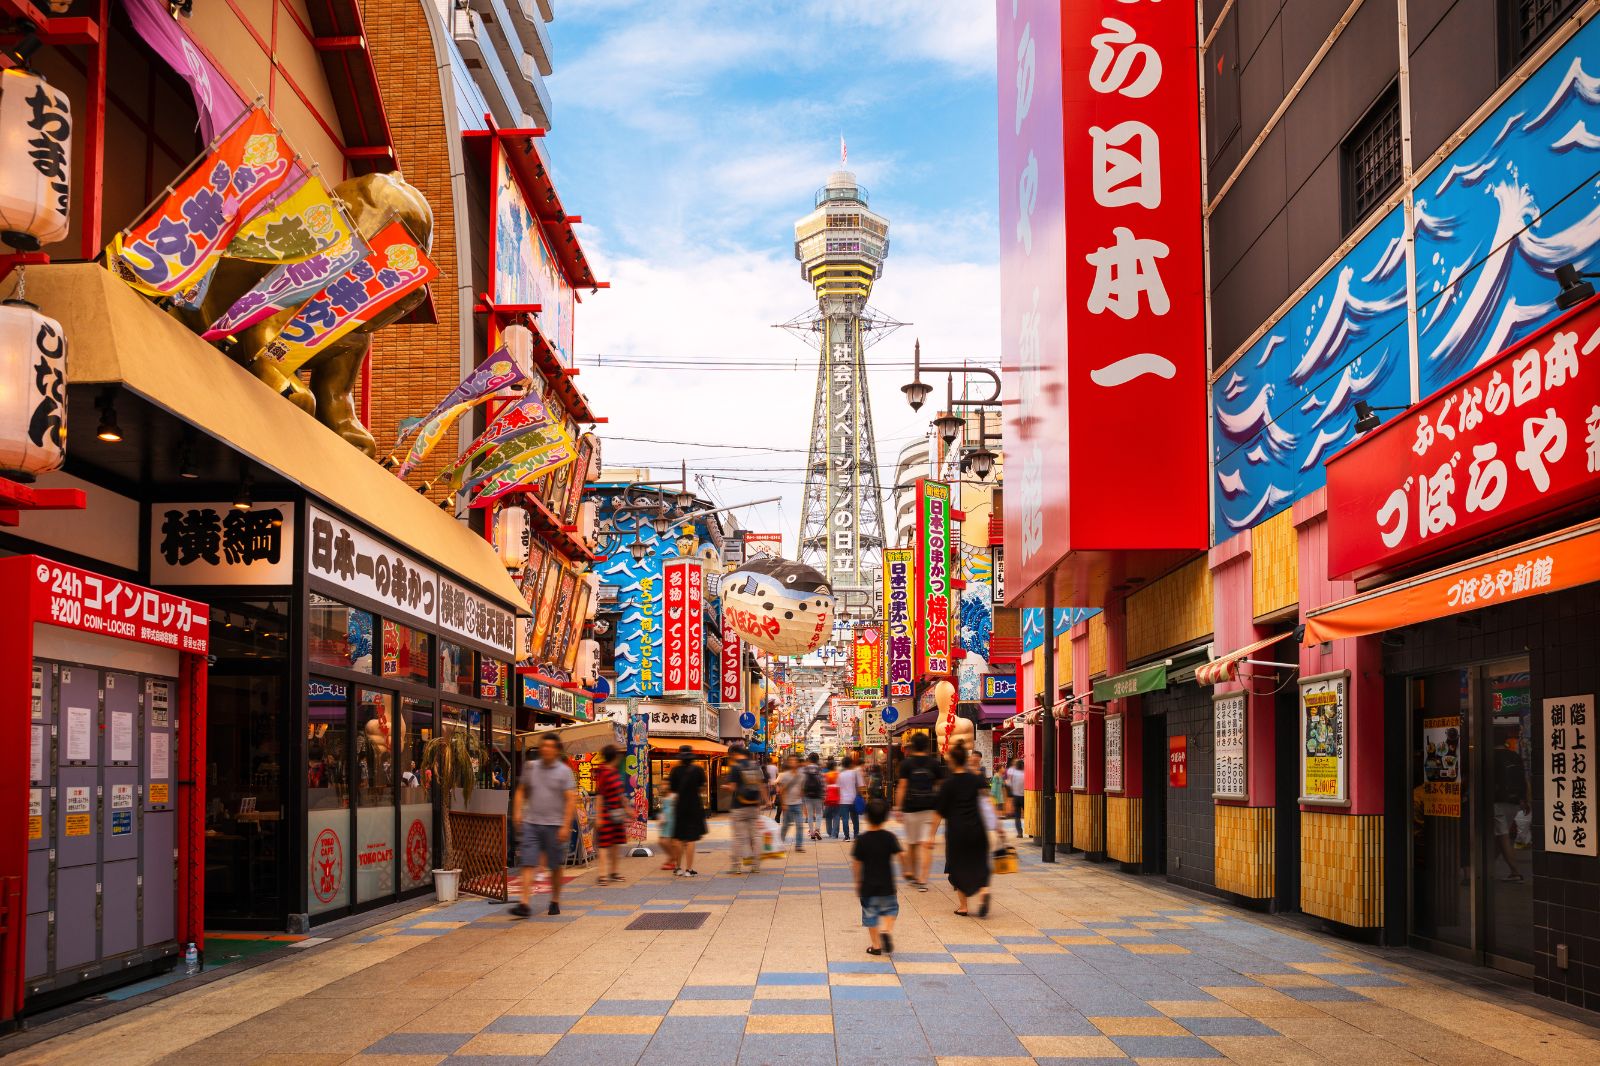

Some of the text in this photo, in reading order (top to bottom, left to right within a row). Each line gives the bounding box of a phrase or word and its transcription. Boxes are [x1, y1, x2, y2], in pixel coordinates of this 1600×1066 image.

[1085, 0, 1176, 387] ら日本一
[832, 343, 854, 573] 社会イノベーションの日立
[1376, 408, 1568, 548] づぼらや
[160, 509, 284, 566] 横綱
[312, 516, 435, 616] 日本一の串かつ
[52, 568, 207, 632] 24h コインロッカー
[889, 562, 908, 635] 日本一の串かつ
[927, 500, 948, 656] 日本一の串かつ 横綱
[1447, 555, 1554, 607] づぼらや新館
[51, 596, 136, 638] ¥200 COIN-LOCKER
[440, 581, 514, 651] 横綱 通天閣店
[668, 570, 683, 685] 名物 てっちり
[689, 570, 701, 685] 名物 てっちり
[929, 657, 947, 673] 酒処
[995, 681, 1016, 694] 日本一
[648, 711, 698, 725] ぼらや本店
[1551, 704, 1567, 846] 御利用下さい
[1569, 702, 1588, 849] 階上お座敷を
[320, 847, 335, 857] CAFE
[321, 838, 335, 847] YOKO
[358, 848, 394, 866] YOKO CAFE
